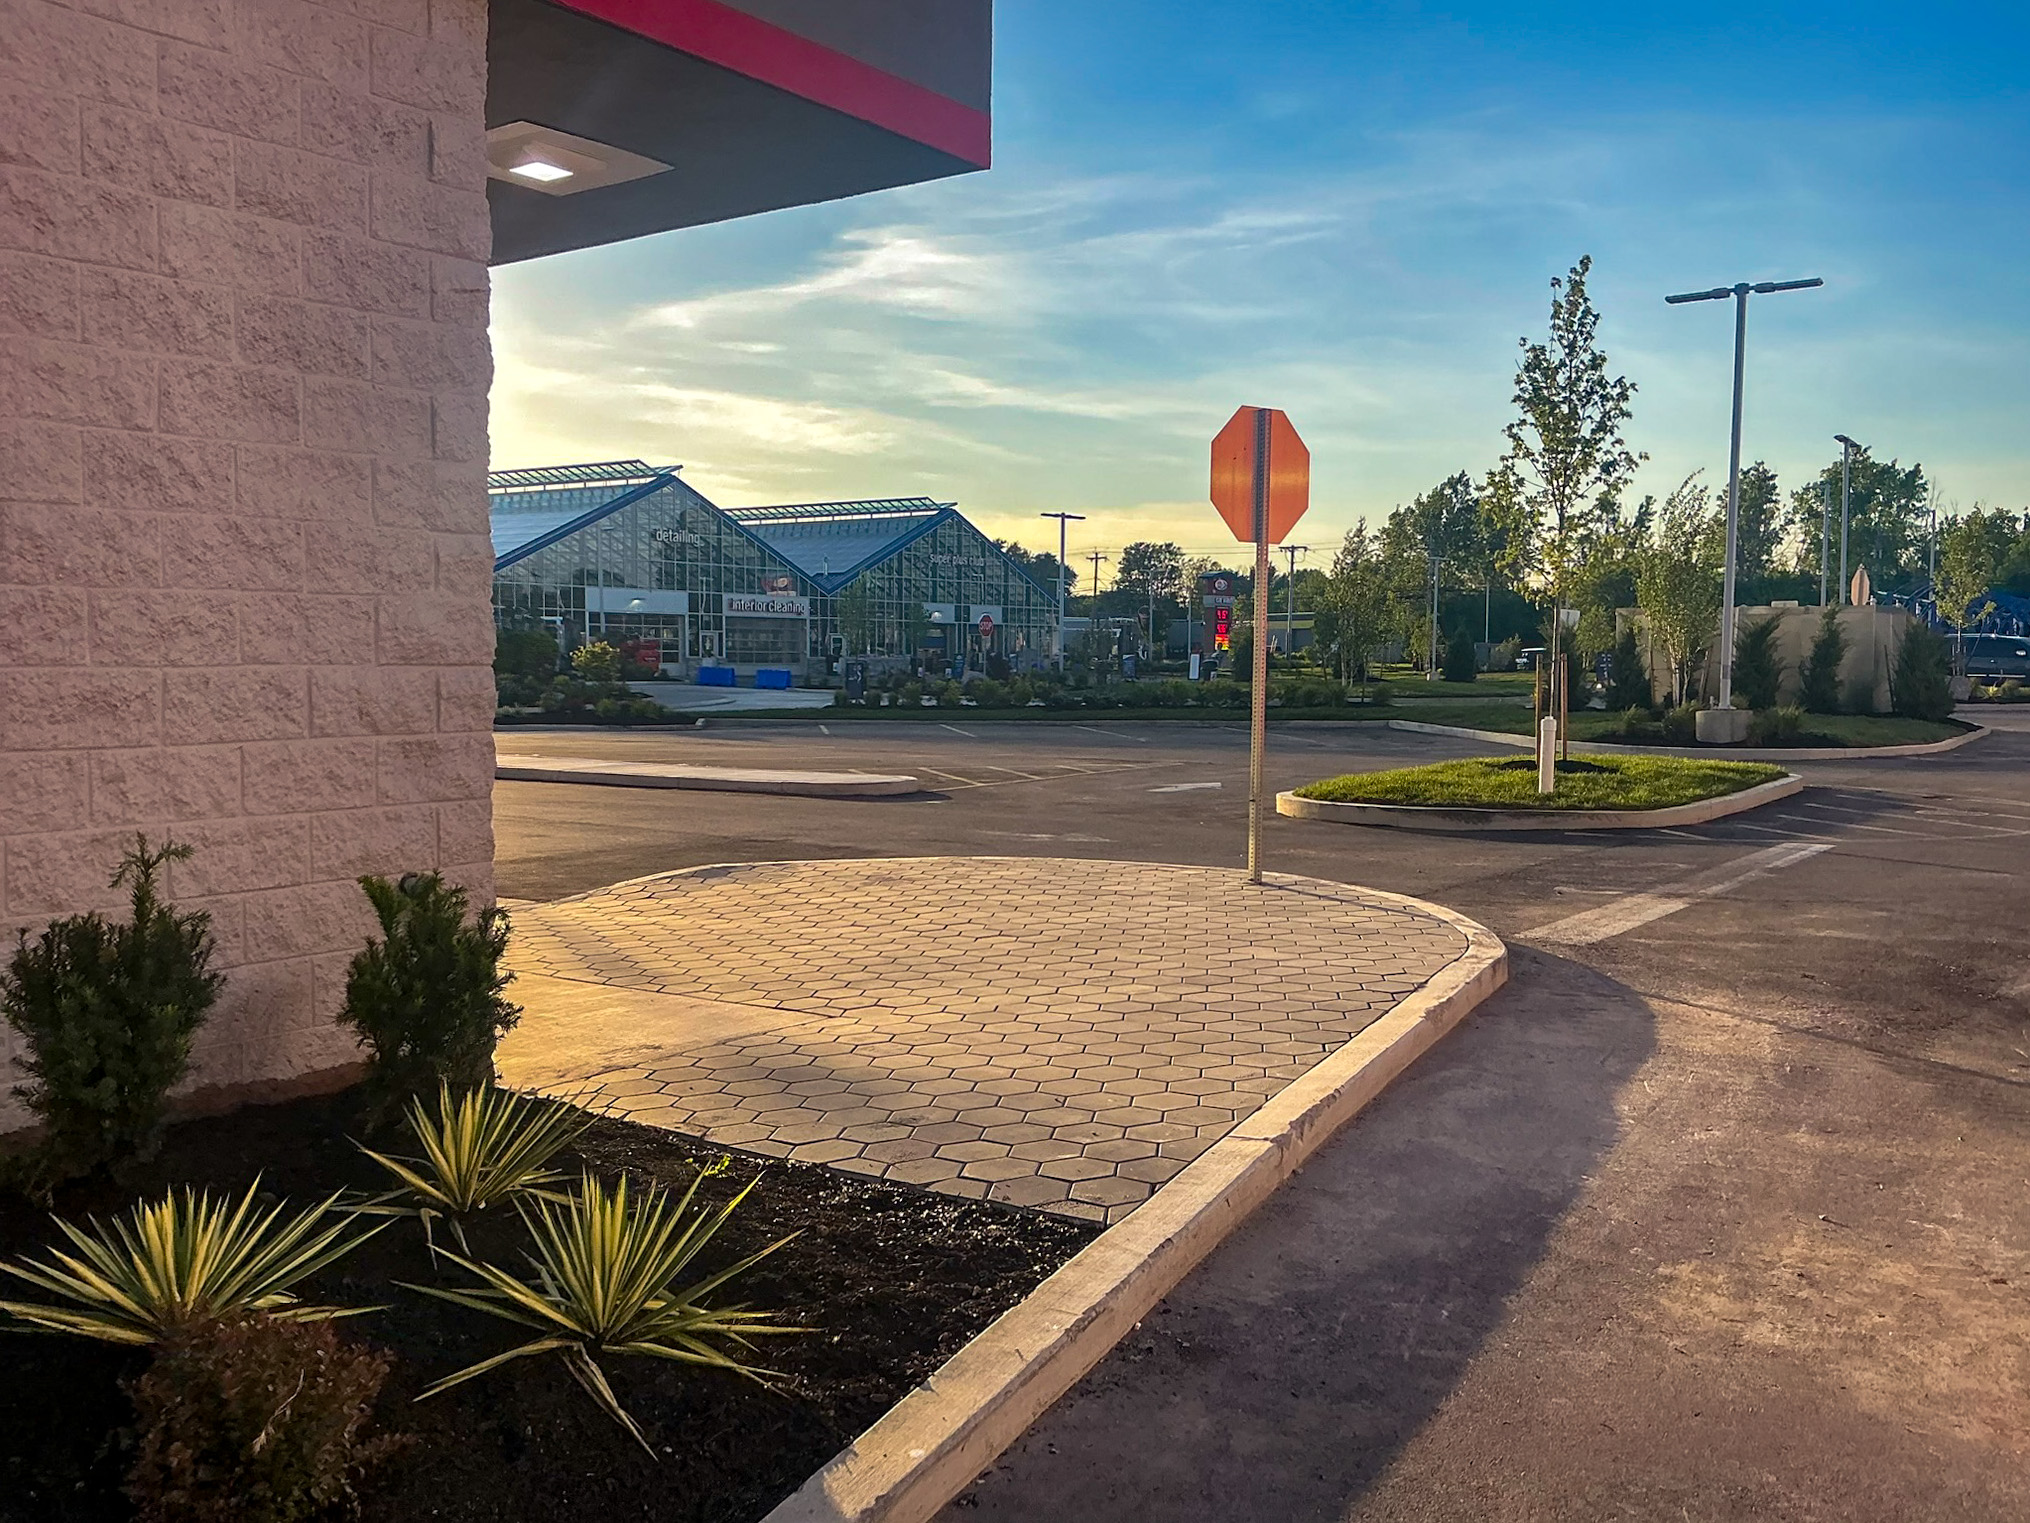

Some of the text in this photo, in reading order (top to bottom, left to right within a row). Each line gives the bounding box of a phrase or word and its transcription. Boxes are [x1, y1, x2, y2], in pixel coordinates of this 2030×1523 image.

[656, 530, 700, 547] detailing
[731, 599, 806, 615] interior cleaning
[980, 621, 992, 630] STOP
